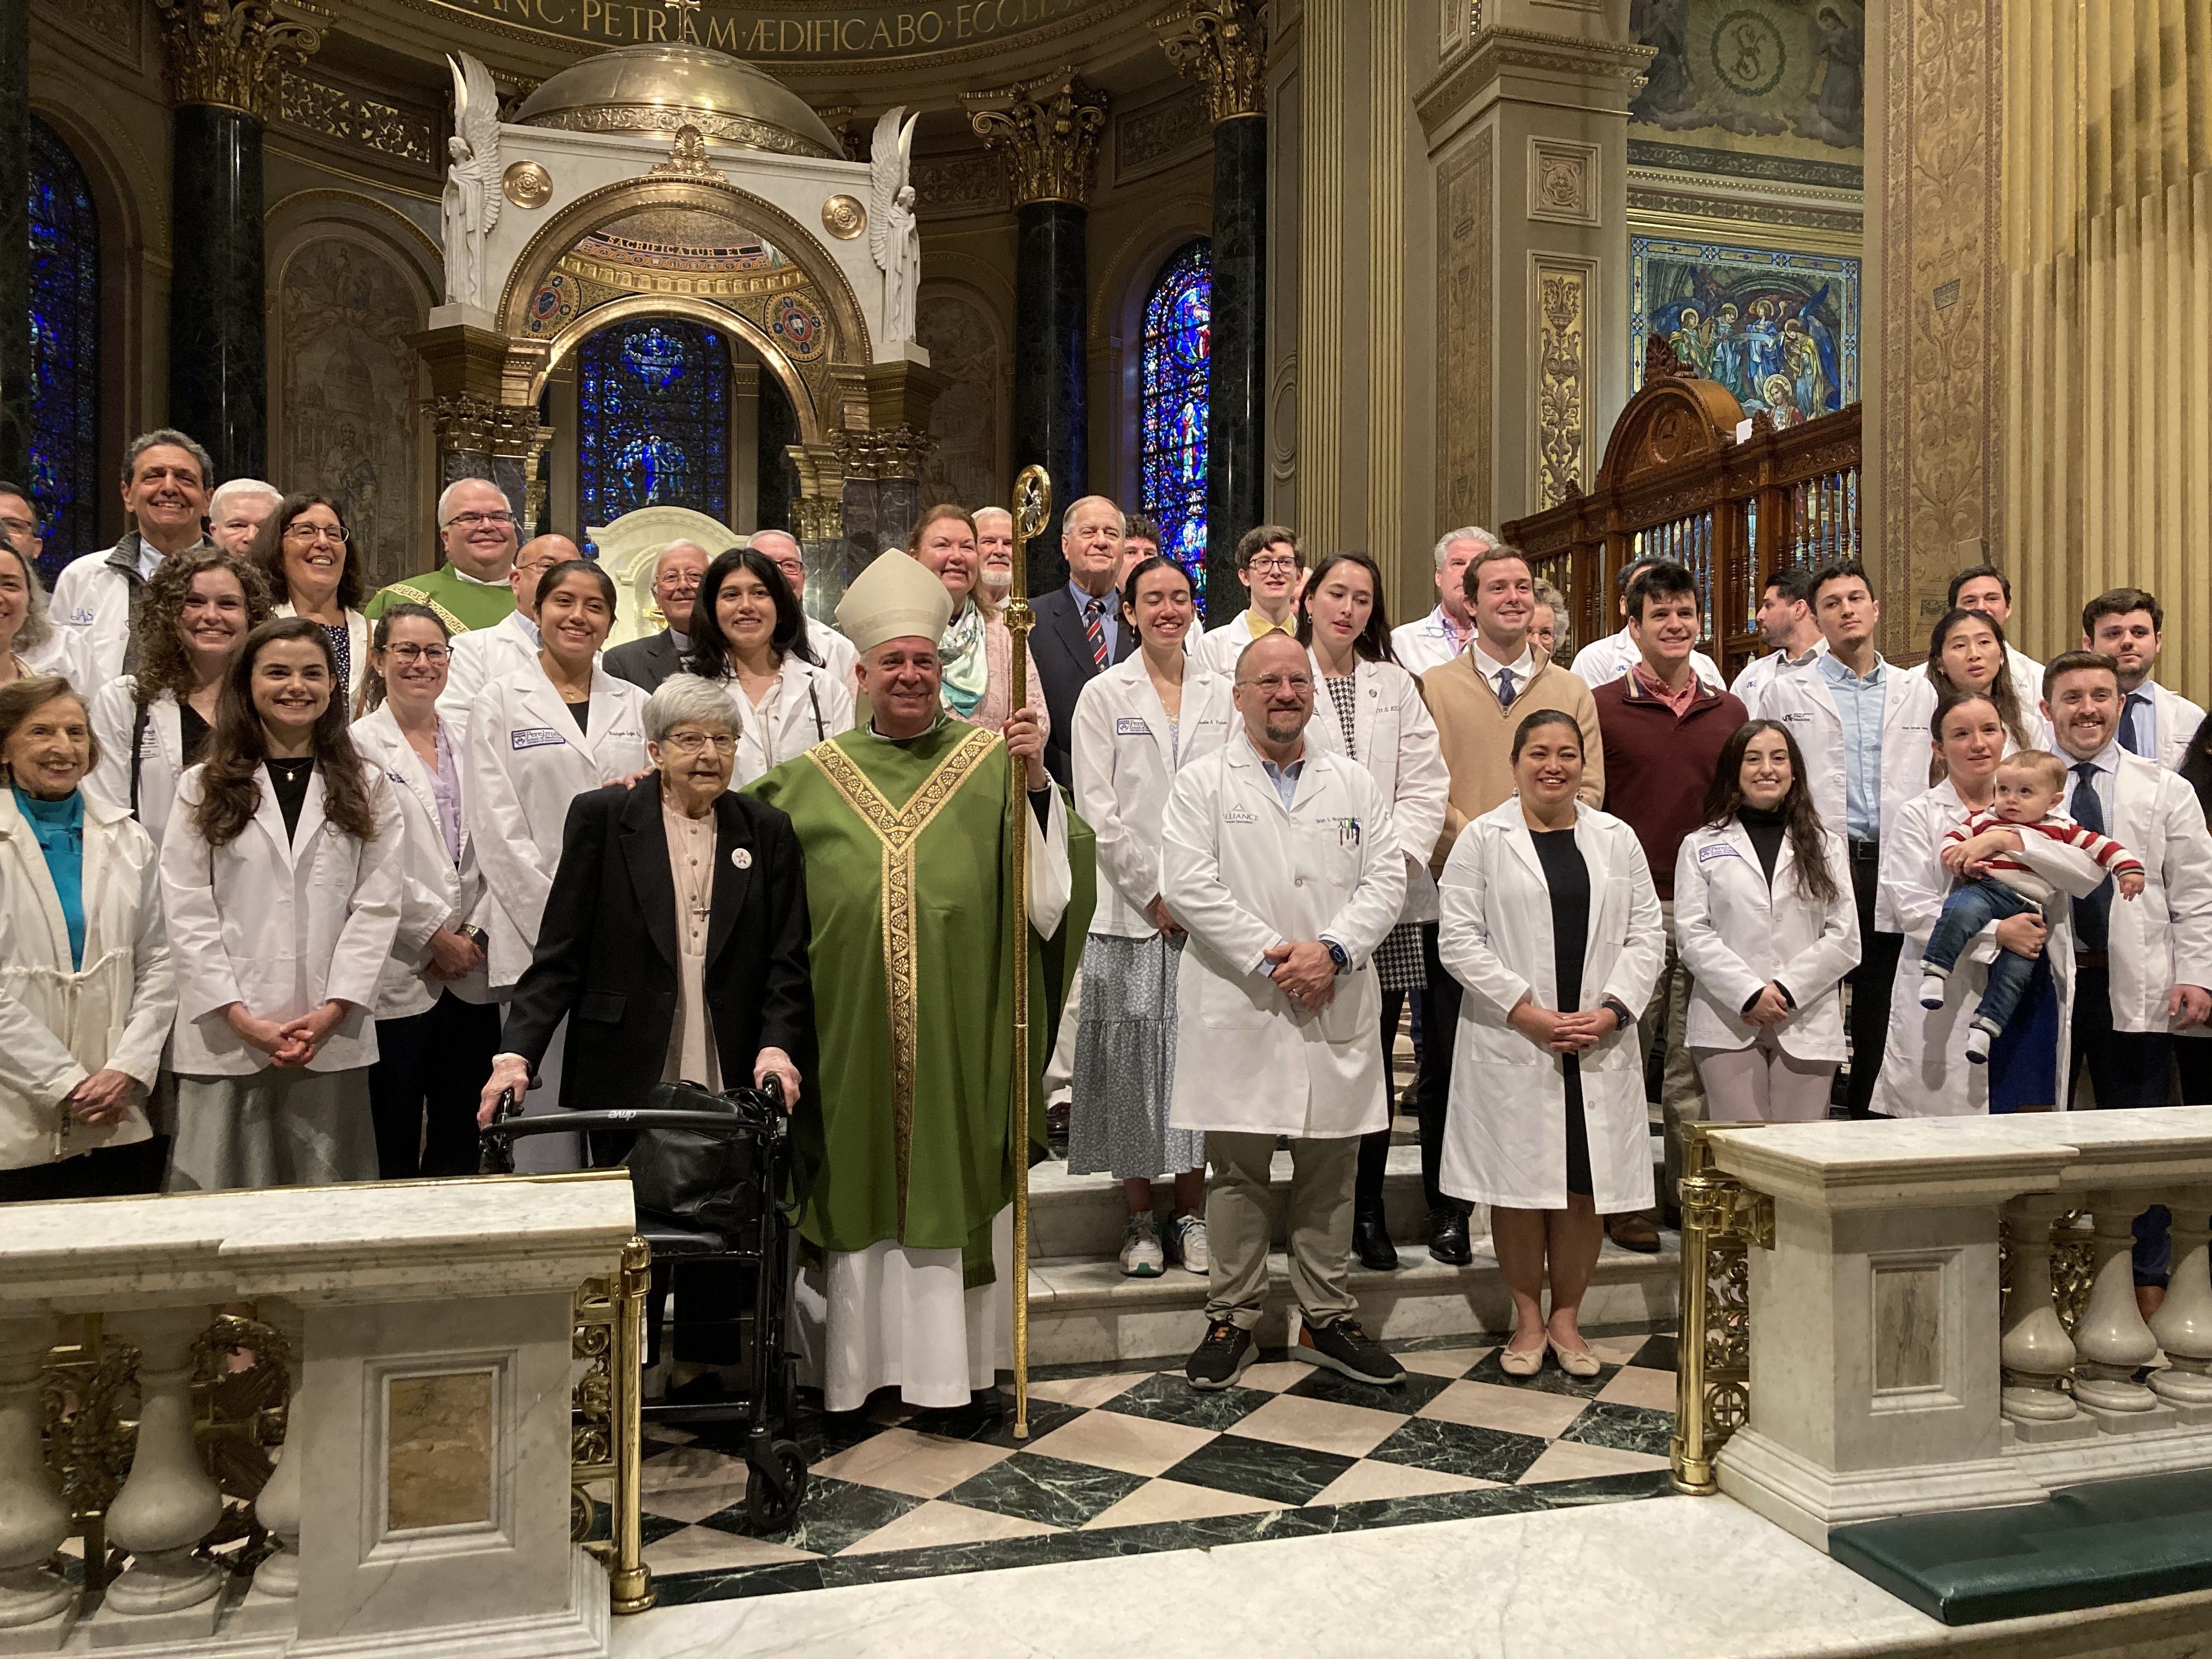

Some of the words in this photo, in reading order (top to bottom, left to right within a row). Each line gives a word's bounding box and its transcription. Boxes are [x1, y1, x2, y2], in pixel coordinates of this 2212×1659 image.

[580, 0, 738, 50] PETRAM
[746, 11, 943, 52] ÆDIFICABO
[607, 236, 714, 256] SACRIFICATUR
[726, 248, 742, 256] ET
[608, 1110, 636, 1121] drive
